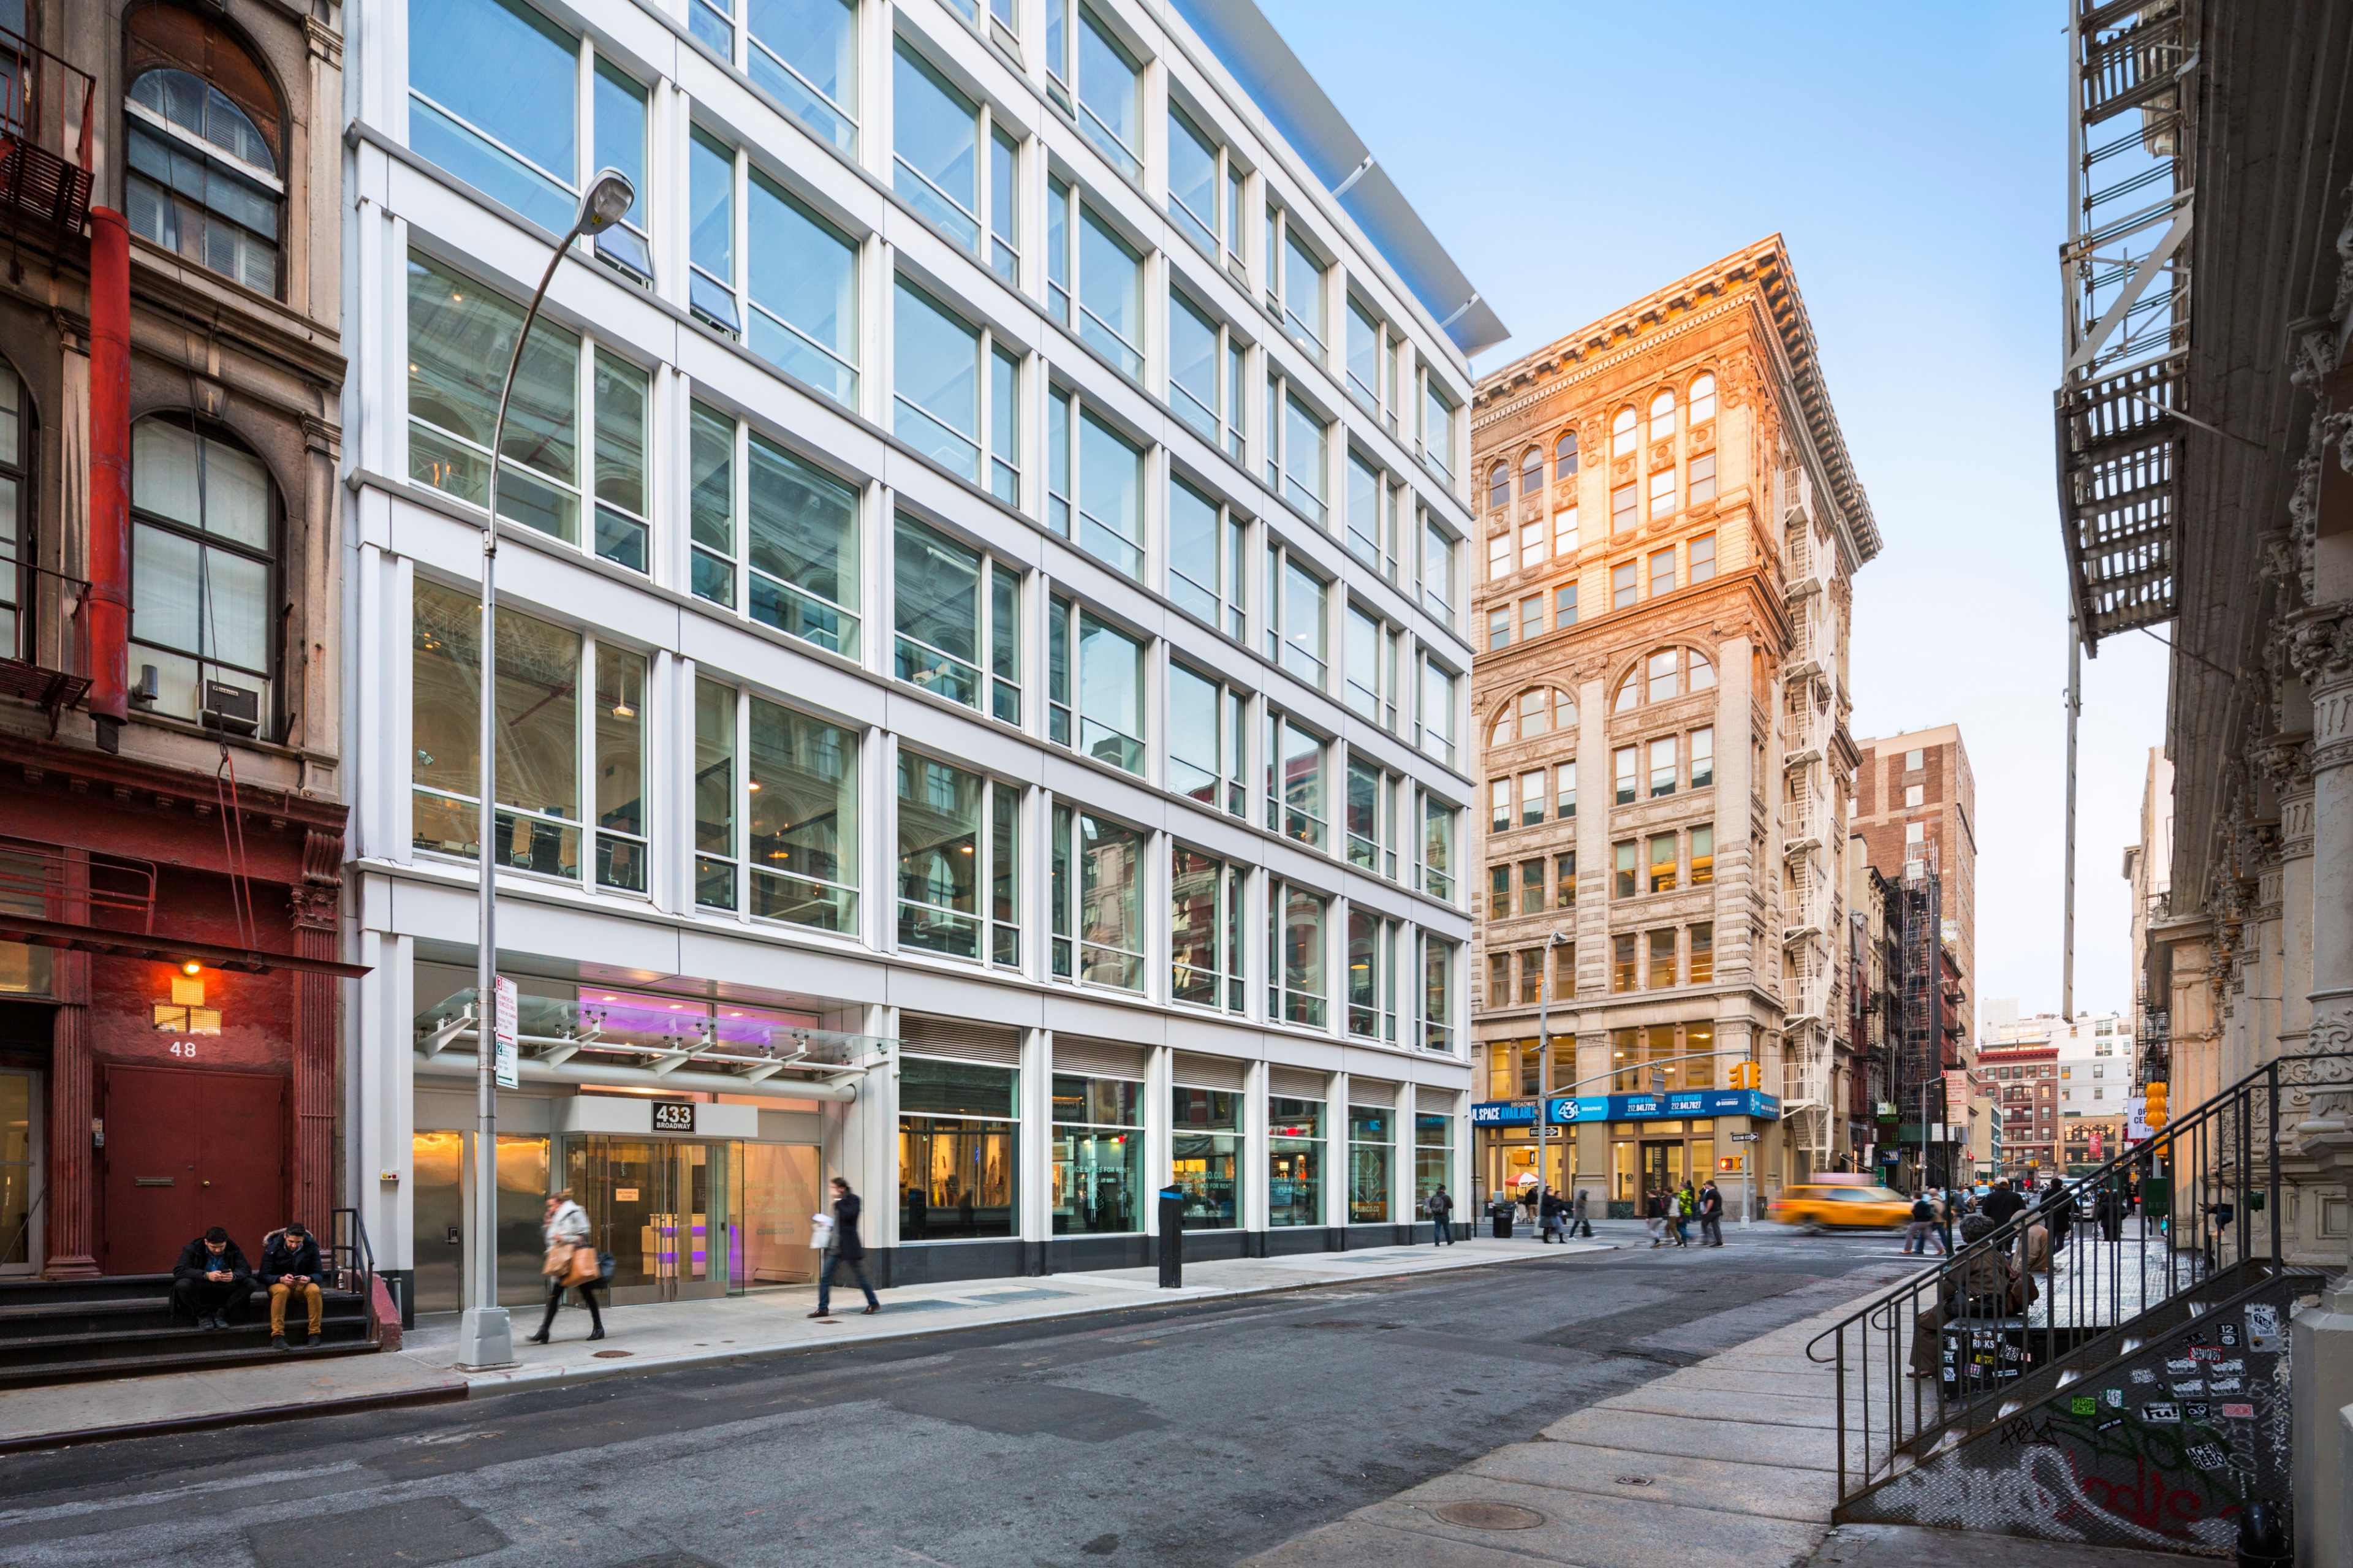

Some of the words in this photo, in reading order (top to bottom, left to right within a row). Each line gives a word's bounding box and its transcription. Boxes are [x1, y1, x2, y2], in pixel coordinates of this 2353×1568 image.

[498, 977, 502, 989] 3
[170, 1041, 196, 1058] 48
[656, 1105, 691, 1123] 433
[1479, 1107, 1500, 1121] SPACE
[2220, 1325, 2234, 1334] 12
[1972, 1339, 1995, 1349] RIKS
[2188, 1443, 2221, 1459] ACEM
[2194, 1454, 2226, 1470] REBO
